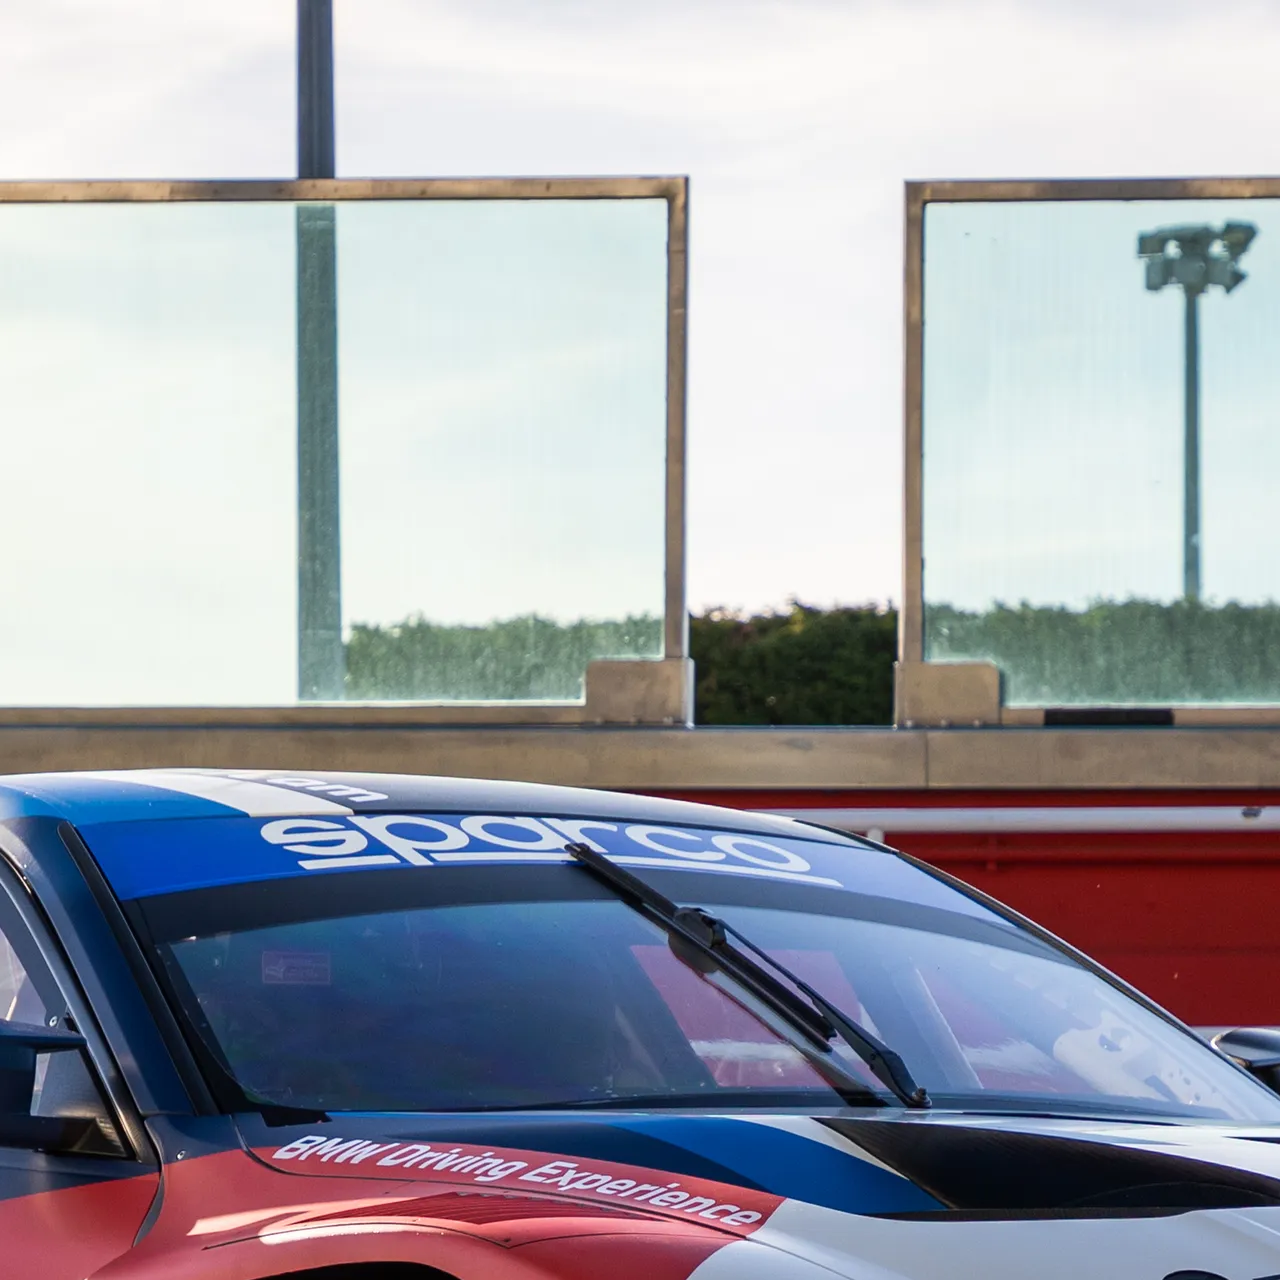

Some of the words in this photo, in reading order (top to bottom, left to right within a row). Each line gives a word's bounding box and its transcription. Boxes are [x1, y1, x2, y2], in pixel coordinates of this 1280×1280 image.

[261, 815, 818, 878] sparco
[272, 1135, 395, 1164] BMW
[378, 1144, 527, 1182] Driving
[518, 1161, 763, 1226] Experience
